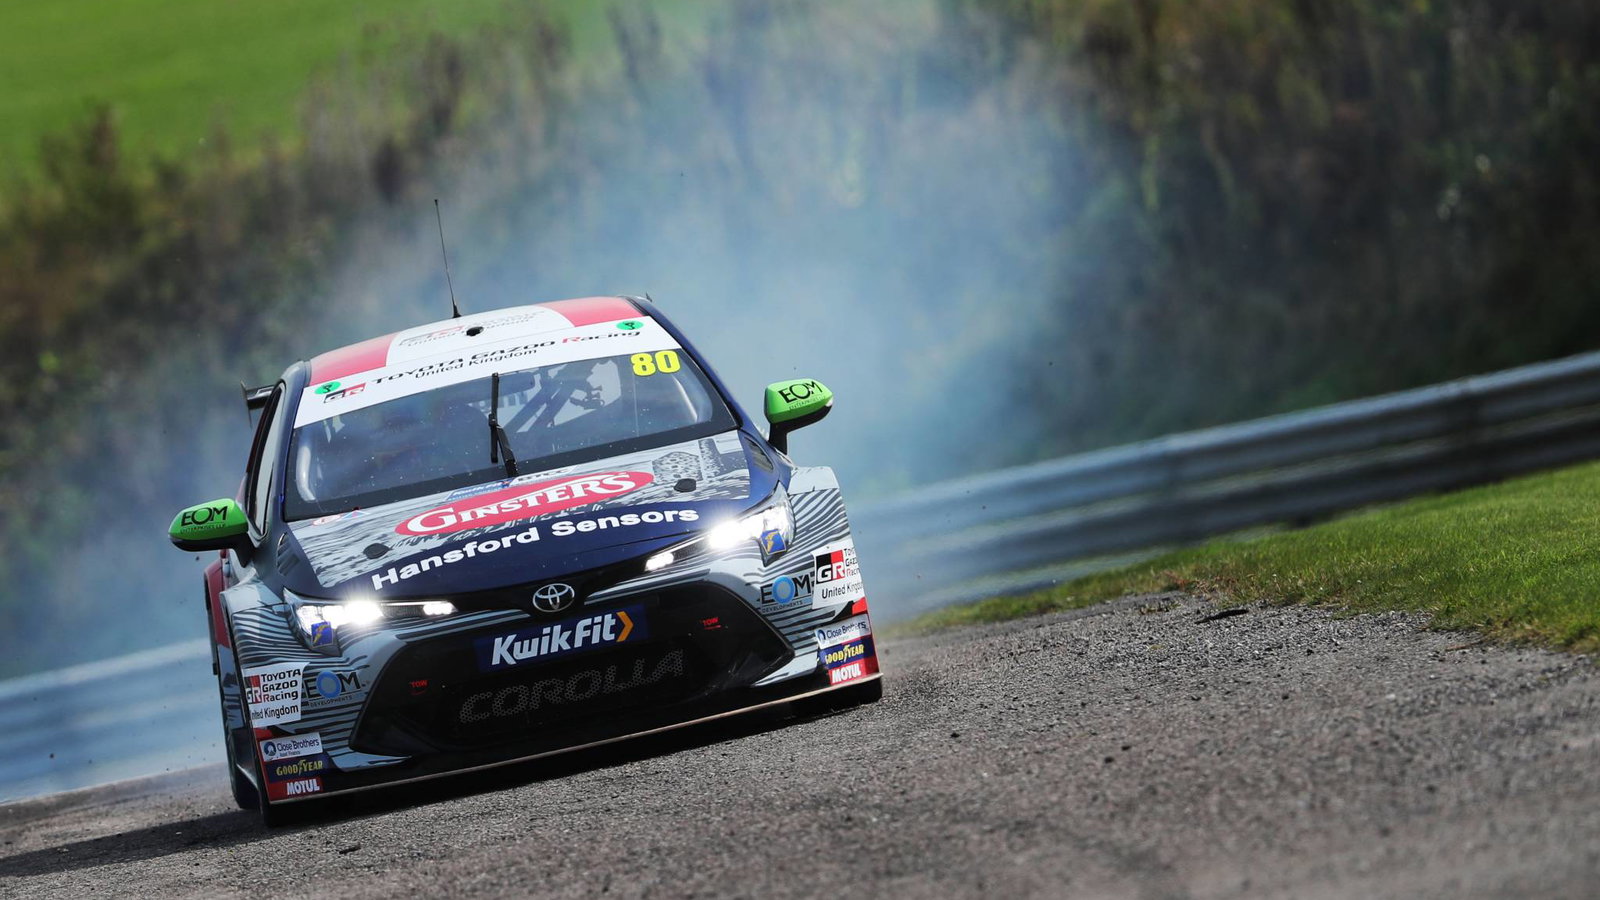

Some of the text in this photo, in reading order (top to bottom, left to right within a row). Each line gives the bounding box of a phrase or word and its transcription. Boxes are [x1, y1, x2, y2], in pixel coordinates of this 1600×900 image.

[371, 330, 641, 384] TOYOTA GAZOO Racing
[415, 350, 537, 379] United Kingdom
[630, 350, 681, 377] 80
[778, 381, 822, 403] EOM
[406, 472, 638, 533] GINSTERS
[181, 506, 229, 527] EOM
[371, 508, 700, 591] Hansford Sensors
[817, 561, 846, 583] GR
[822, 584, 846, 599] United
[826, 628, 842, 639] Close
[842, 621, 867, 634] Brothrs
[261, 669, 301, 682] TOYOTA
[831, 663, 862, 683] MOTUL
[246, 686, 262, 704] GR
[262, 680, 298, 693] GAZOO
[459, 648, 685, 723] COROLLA
[263, 690, 299, 703] Racing
[264, 704, 299, 719] Kingdom
[277, 738, 320, 752] Close Brothers
[276, 760, 323, 776] GOODYEAR
[287, 778, 320, 795] MOTUL
